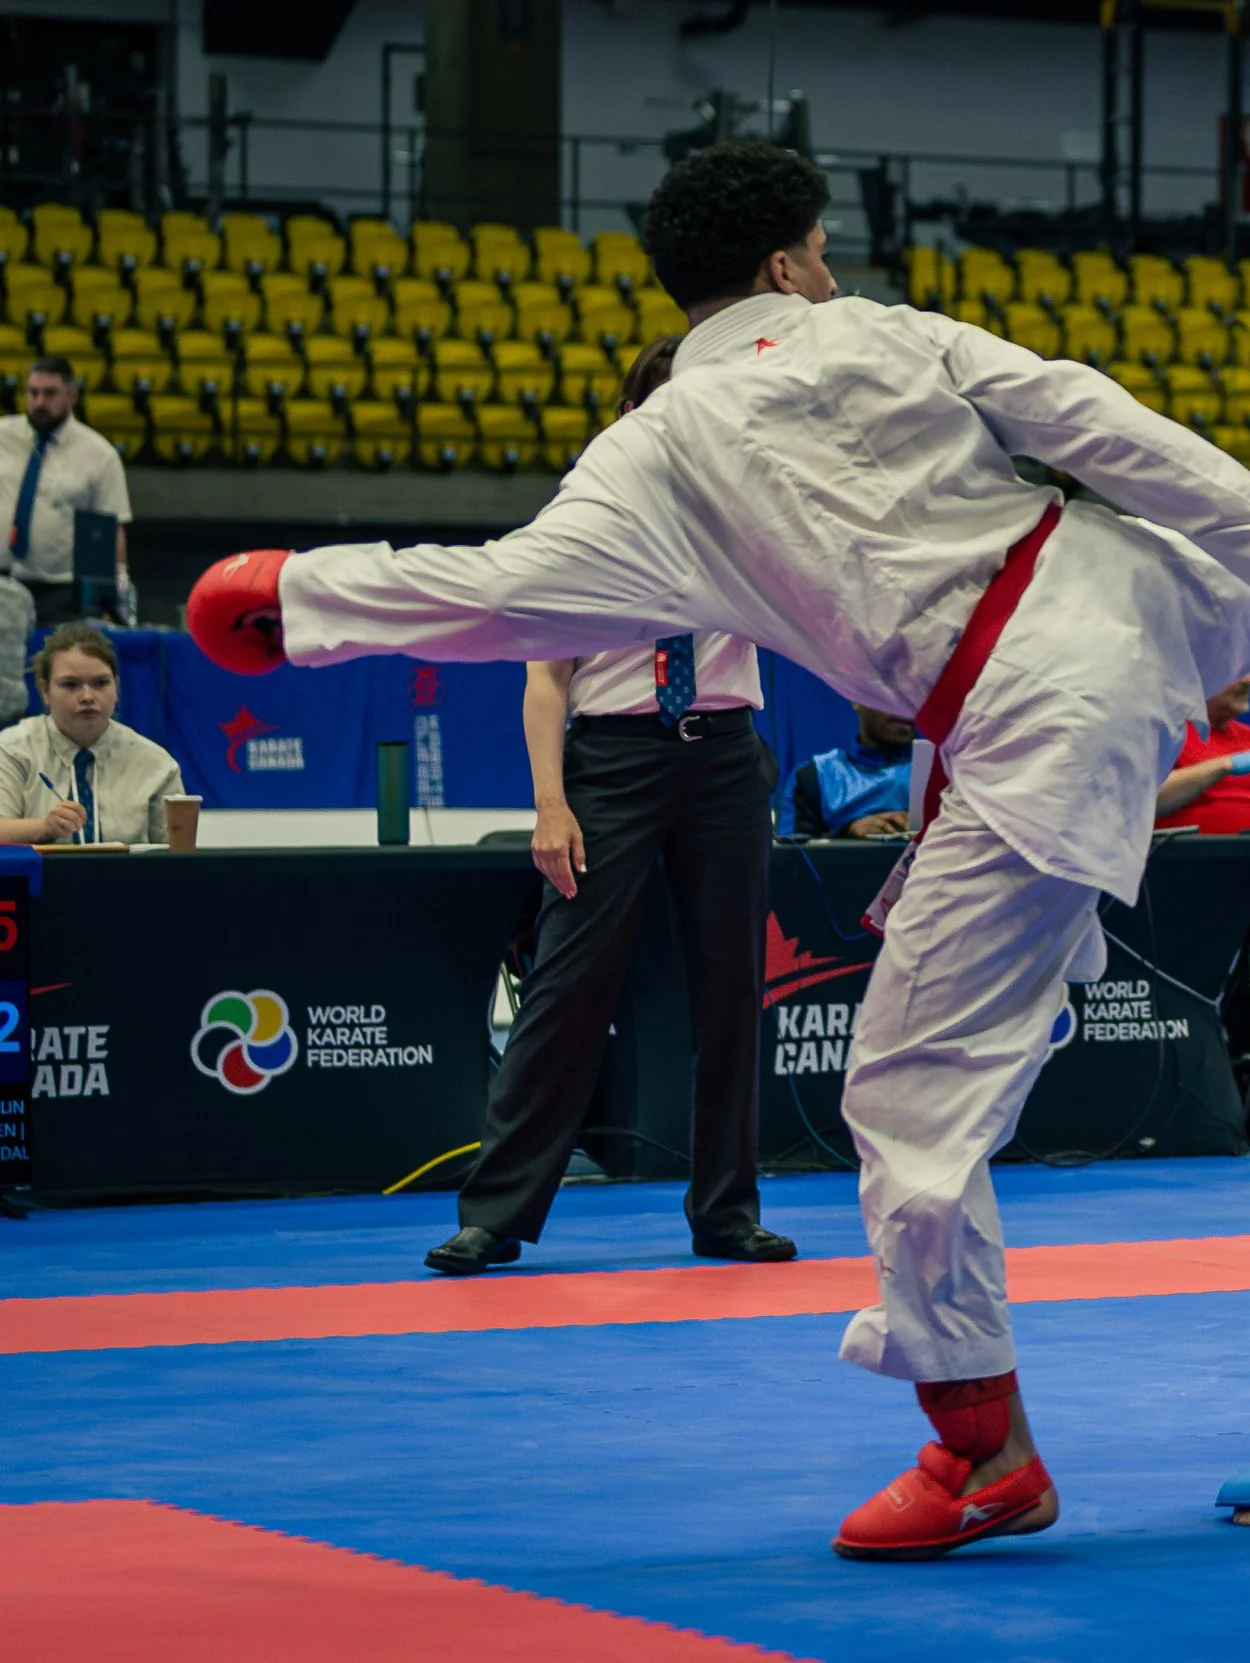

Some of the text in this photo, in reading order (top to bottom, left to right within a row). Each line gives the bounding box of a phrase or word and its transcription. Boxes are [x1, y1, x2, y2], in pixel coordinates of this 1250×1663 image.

[1084, 980, 1150, 1000] WORLD
[307, 1004, 386, 1025] WORLD
[1083, 1001, 1152, 1020] KARATE
[307, 1026, 388, 1046] KARATE
[307, 1044, 433, 1068] FEDERATION
